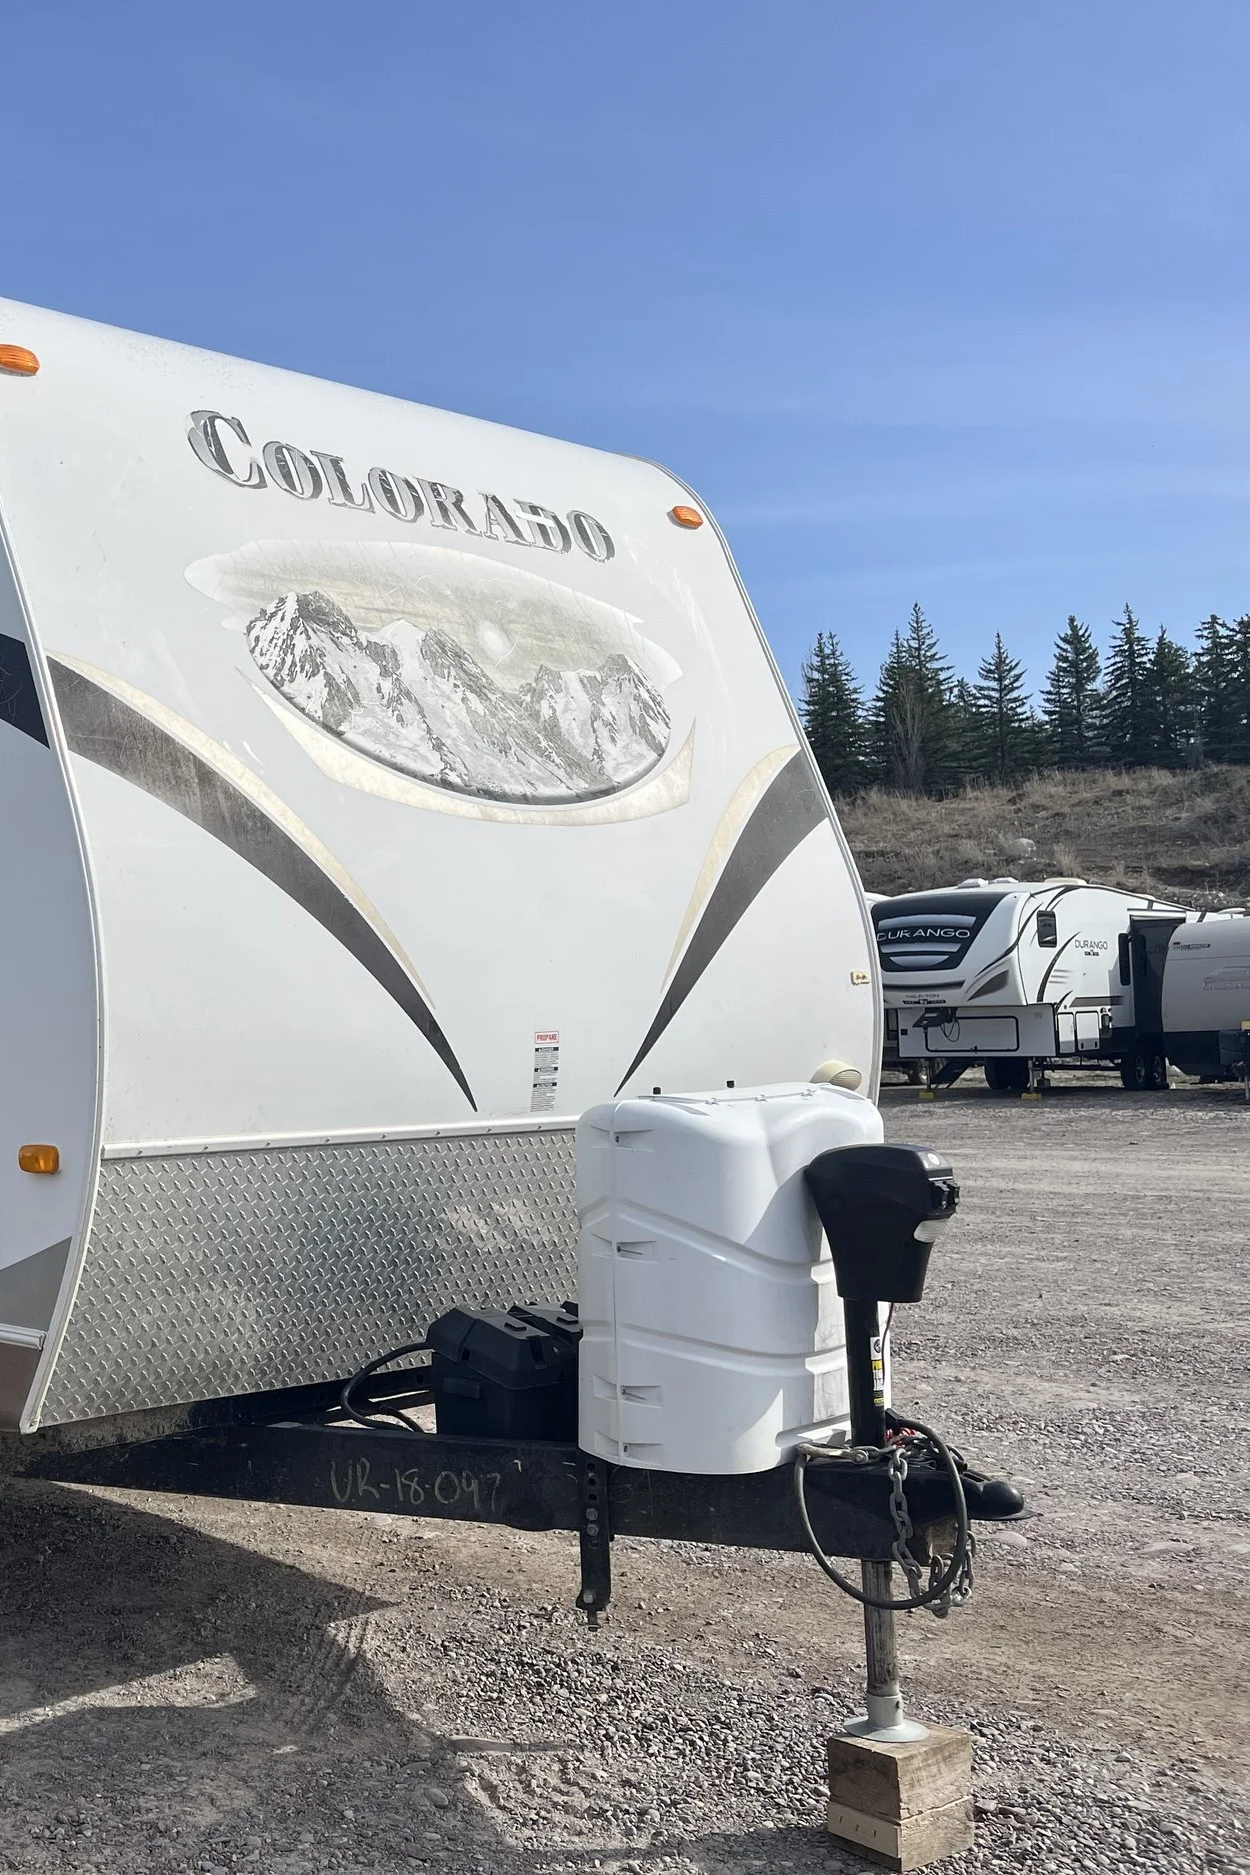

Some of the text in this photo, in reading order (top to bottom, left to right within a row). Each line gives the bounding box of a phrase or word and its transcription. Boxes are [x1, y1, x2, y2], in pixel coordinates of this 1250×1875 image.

[184, 409, 616, 564] COLORADO
[876, 928, 971, 941] DURANGO
[1074, 939, 1109, 950] DURANGO
[536, 1033, 558, 1042] PROPANE
